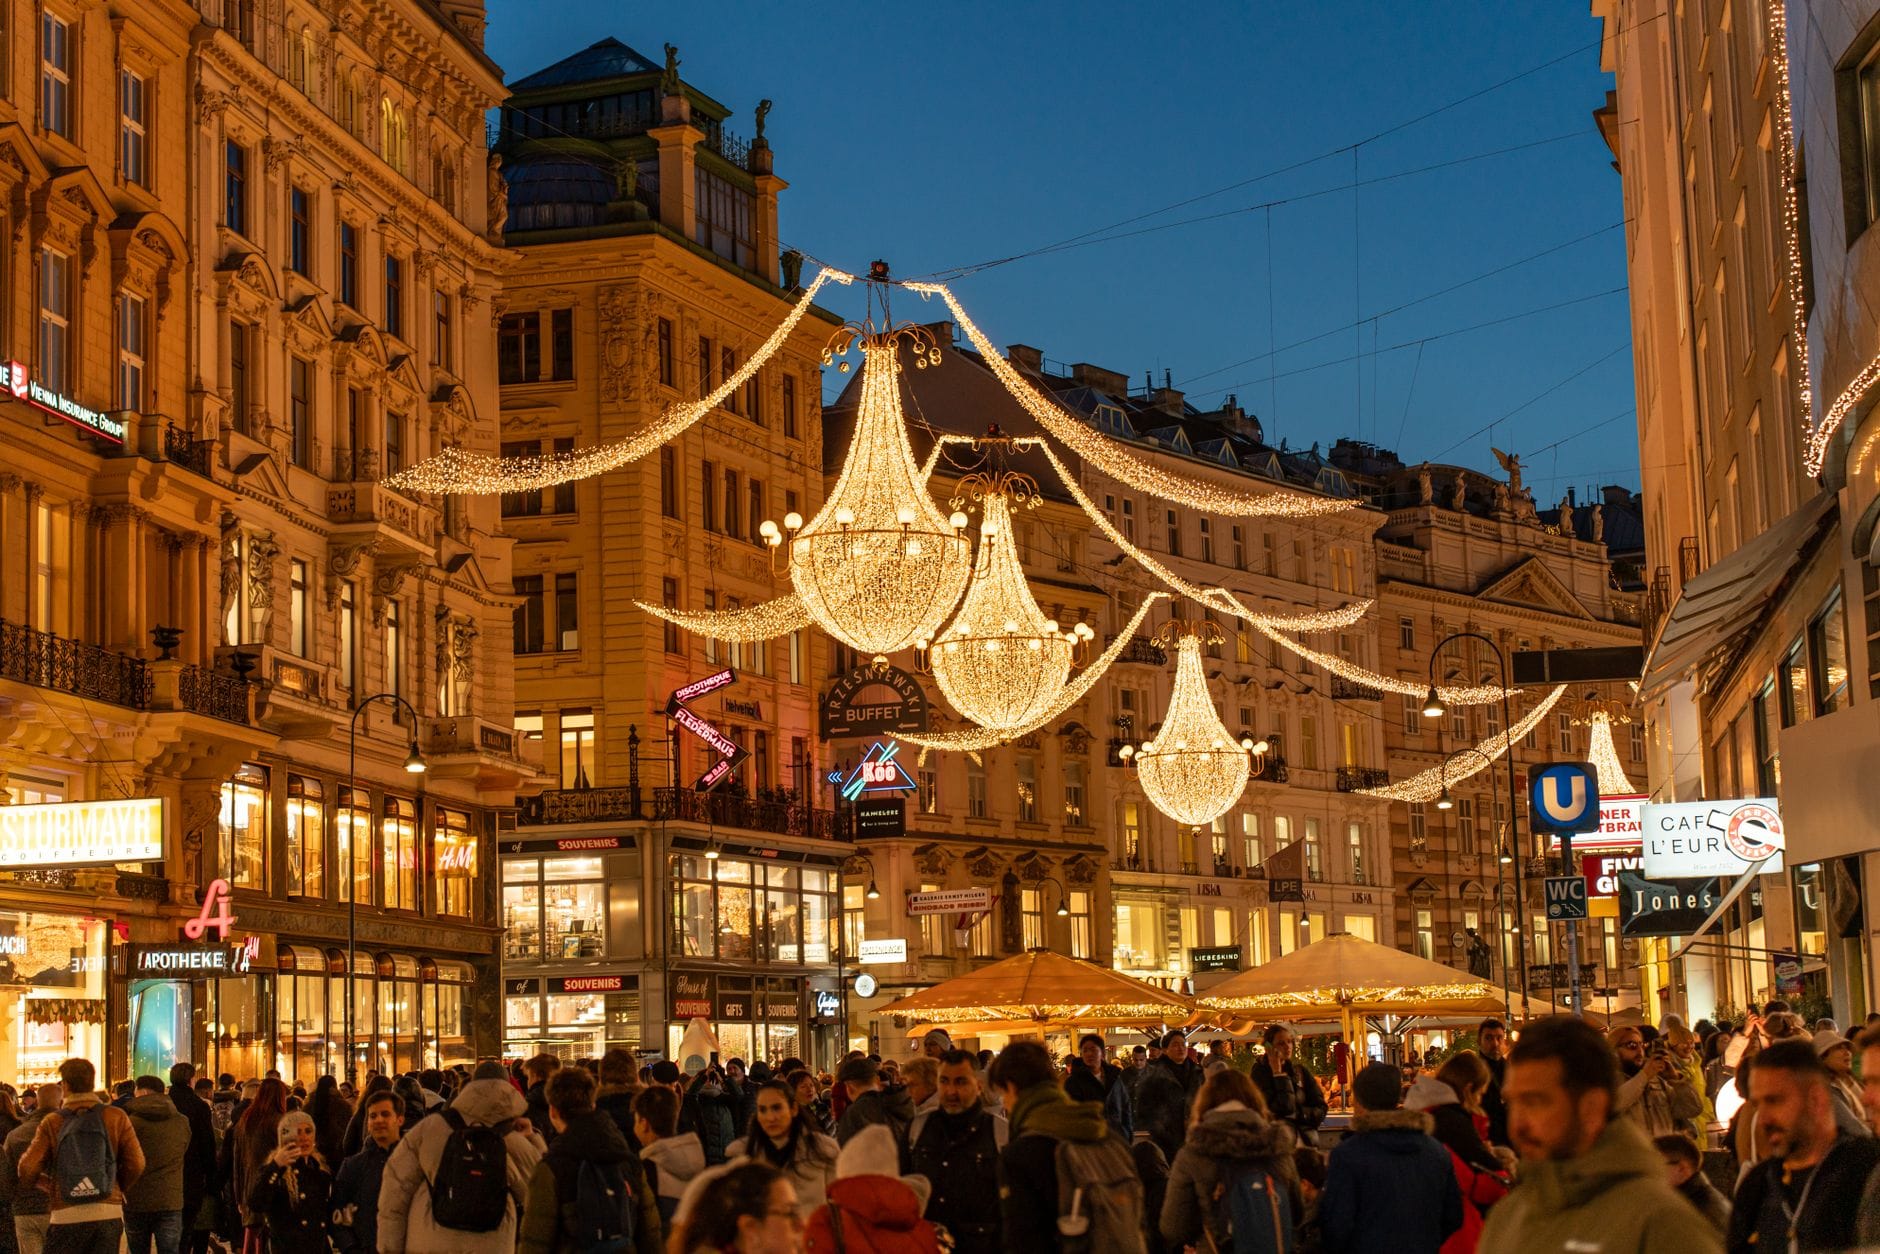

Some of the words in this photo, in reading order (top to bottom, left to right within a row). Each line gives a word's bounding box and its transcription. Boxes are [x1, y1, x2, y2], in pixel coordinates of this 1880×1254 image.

[676, 670, 731, 698] DISCOTHEQUE
[846, 705, 902, 721] BUFFET
[674, 710, 736, 758] FLEDERMAUS
[712, 761, 728, 777] BAR
[1542, 775, 1586, 822] U
[1599, 820, 1641, 833] TBRÄ
[1735, 807, 1778, 828] TABAK
[511, 841, 523, 855] of
[558, 838, 619, 850] SOUVENIRS
[1729, 830, 1769, 857] TRAFIK
[439, 845, 474, 870] H&M
[1547, 881, 1583, 900] WC
[1632, 890, 1712, 916] Jones
[144, 951, 224, 969] APOTHEKE
[1194, 953, 1239, 961] LIEBESKIND
[516, 979, 529, 994] of
[564, 978, 621, 990] SOUVENIRS
[676, 975, 699, 994] House
[699, 977, 709, 999] of
[675, 1001, 711, 1016] SOUVENIRS
[725, 1003, 743, 1017] GIFTS
[757, 1005, 762, 1016] &
[768, 1004, 798, 1017] SOUVENIRS
